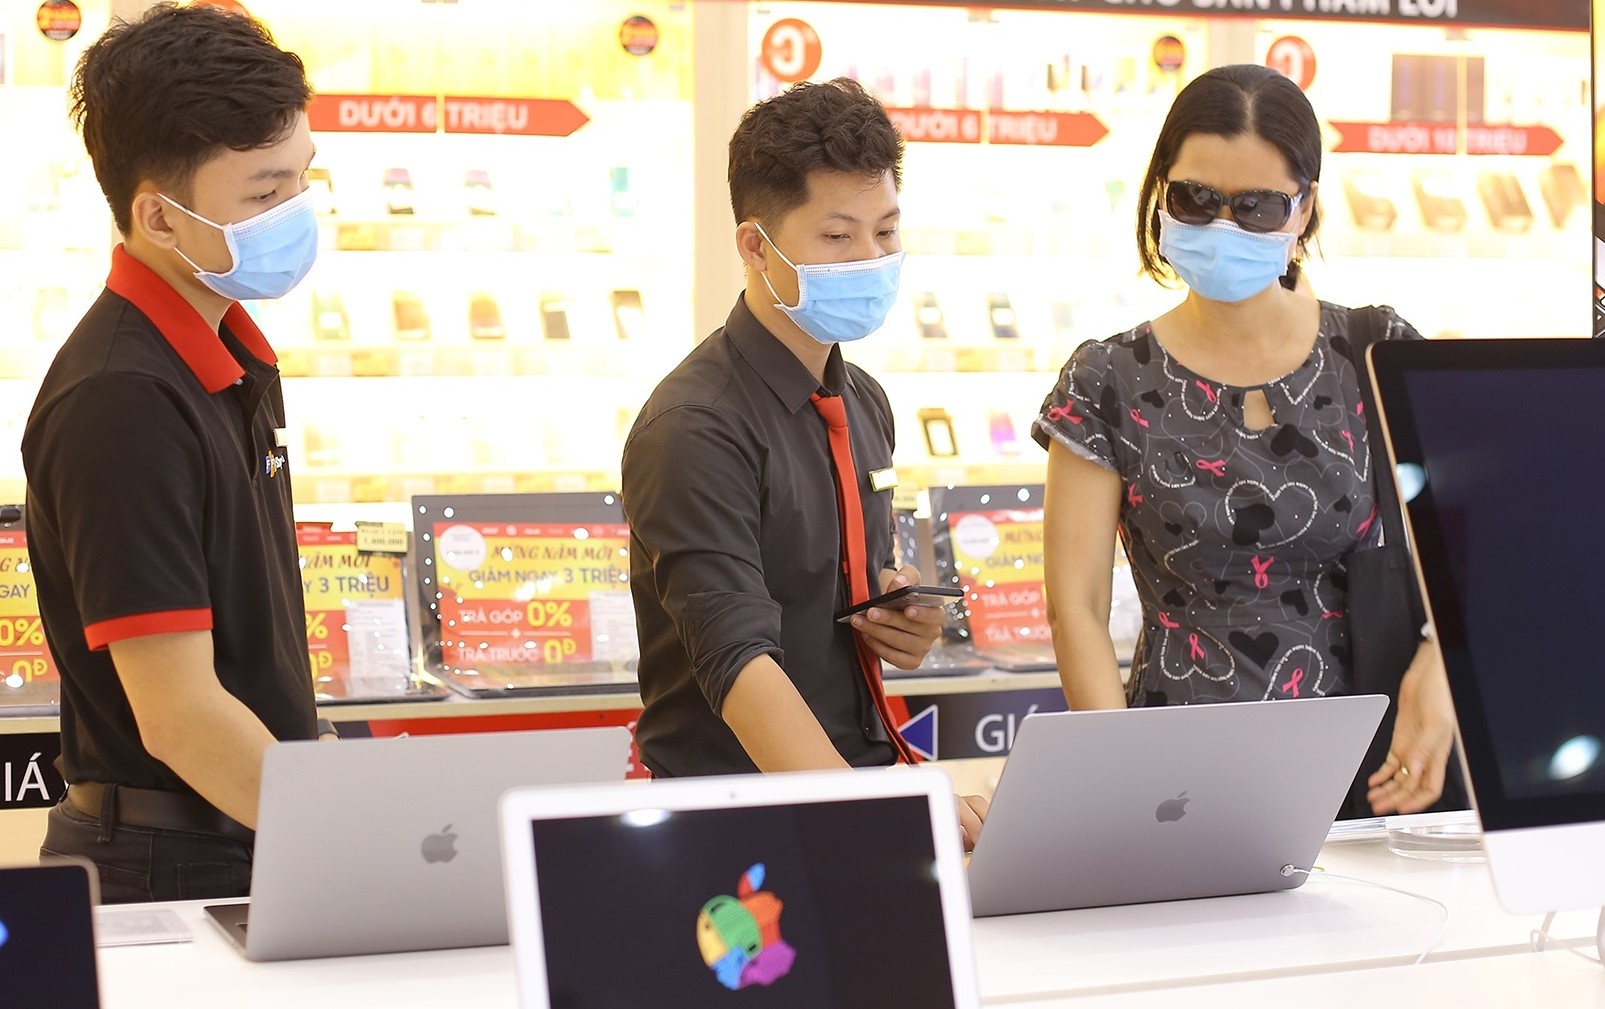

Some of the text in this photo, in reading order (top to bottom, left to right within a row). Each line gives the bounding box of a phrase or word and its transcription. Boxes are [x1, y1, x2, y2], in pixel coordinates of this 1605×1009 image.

[339, 97, 417, 127] DƯỚI
[446, 102, 529, 133] TRIỆU
[319, 577, 330, 594] 3
[335, 571, 390, 598] TRIỆU
[564, 568, 574, 584] 3
[489, 606, 525, 625] GÓP
[526, 600, 573, 628] 0%
